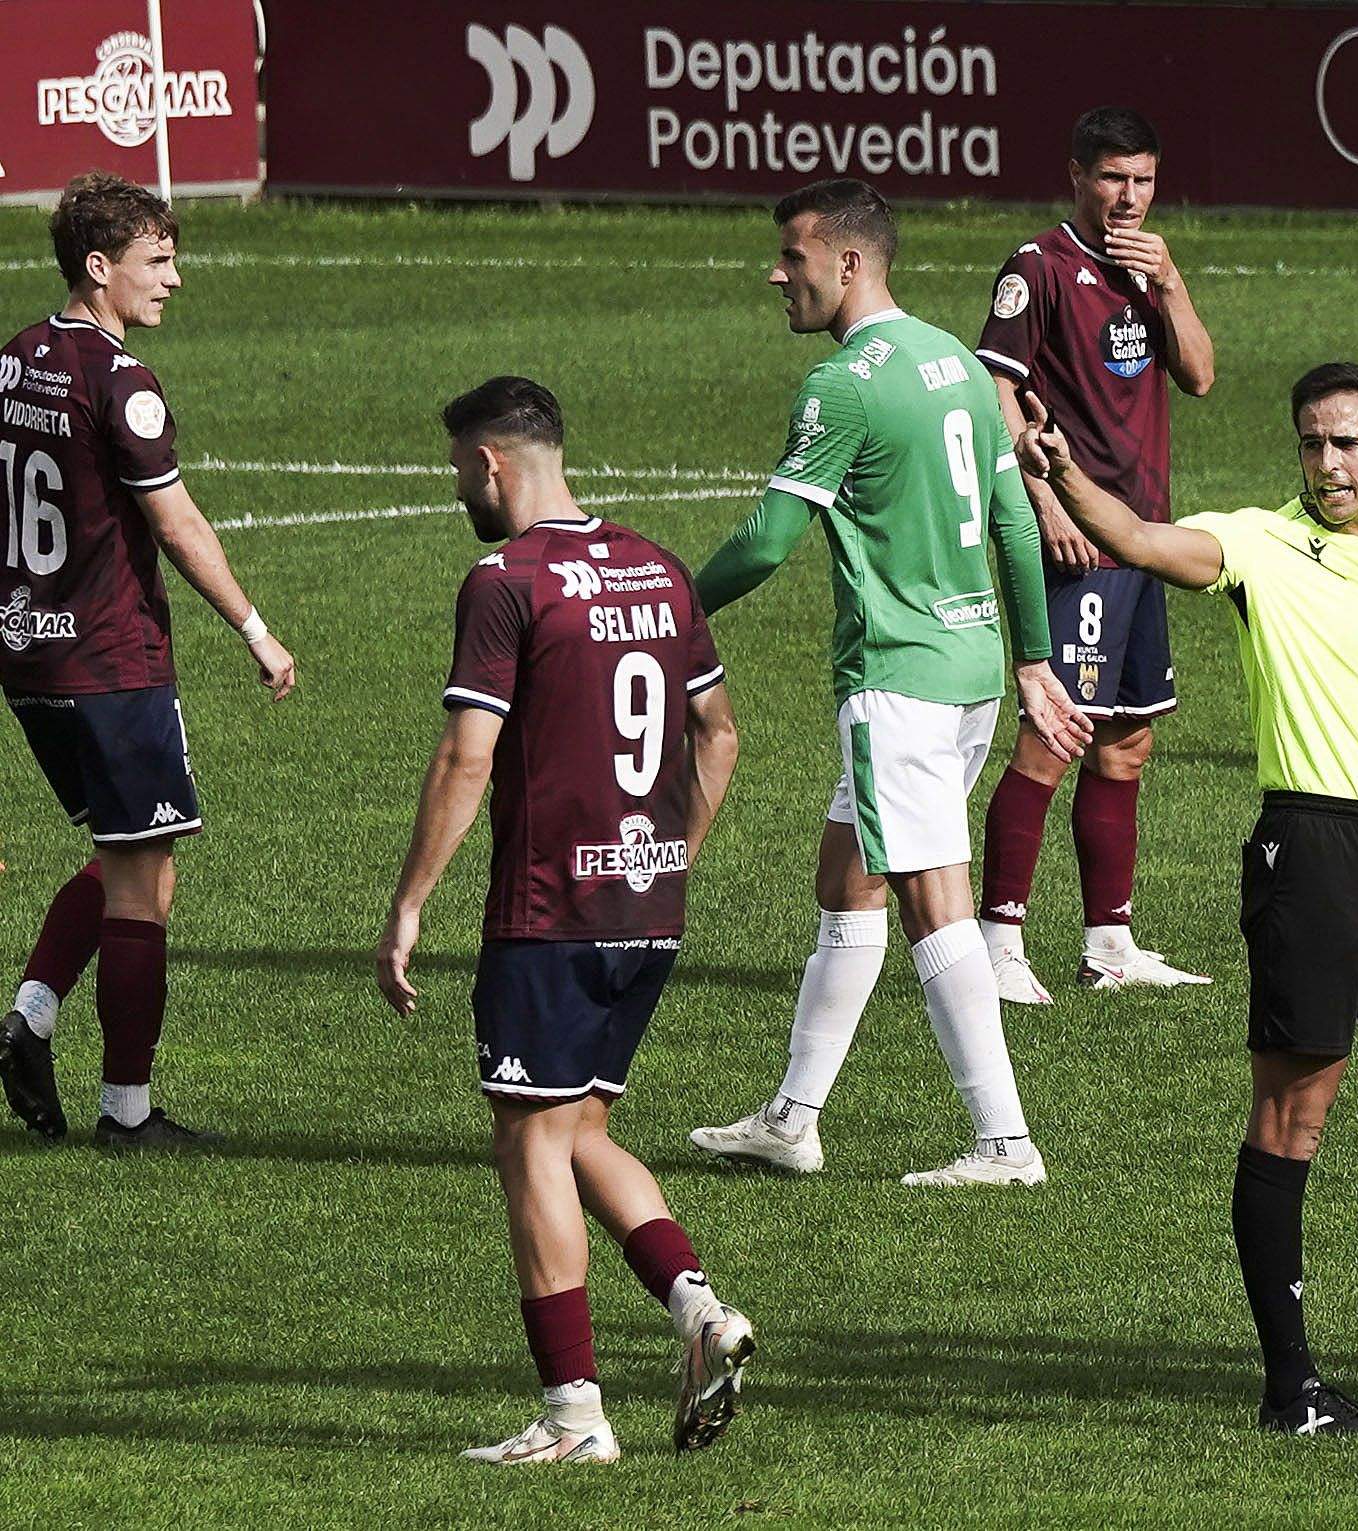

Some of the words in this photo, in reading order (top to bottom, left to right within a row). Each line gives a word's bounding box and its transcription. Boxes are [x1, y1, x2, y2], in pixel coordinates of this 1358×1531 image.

[96, 31, 156, 61] CONSERVA
[645, 26, 998, 112] Deputación
[648, 107, 999, 177] Pontevedra
[3, 398, 72, 438] VIDORRETA
[943, 408, 982, 549] 9
[0, 439, 67, 576] 16
[600, 561, 667, 580] Deputación
[604, 576, 673, 594] Pontevedra
[588, 602, 678, 643] SELMA
[1079, 591, 1103, 646] 8
[613, 650, 667, 798] 9
